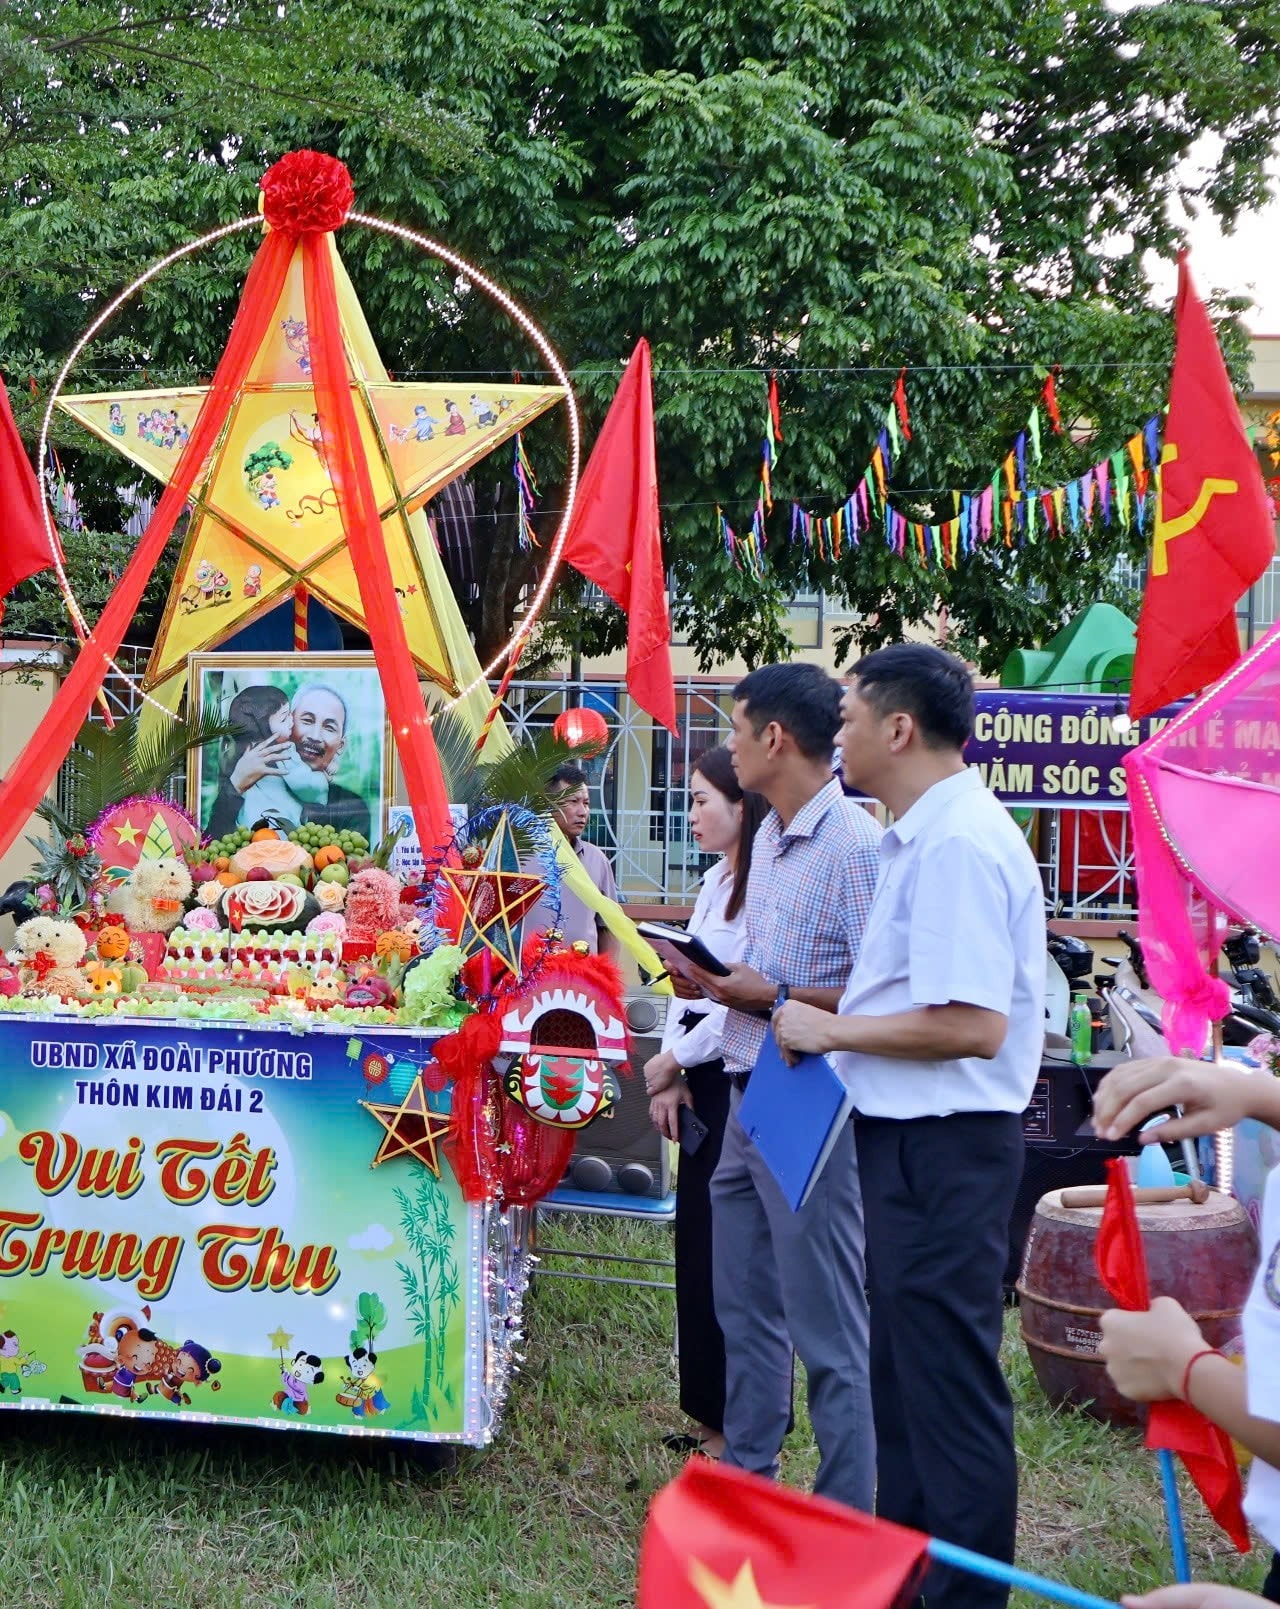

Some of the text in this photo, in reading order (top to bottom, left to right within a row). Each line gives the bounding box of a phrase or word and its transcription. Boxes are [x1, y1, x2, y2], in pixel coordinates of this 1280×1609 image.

[975, 707, 1052, 748] CỘNG
[1061, 706, 1140, 746] ĐỒNG
[1042, 760, 1100, 795] SÓC
[31, 1040, 313, 1080] UBND XÃ ĐOÀI PHƯƠNG
[75, 1077, 264, 1113] THÔN KIM ĐÁI 2
[18, 1130, 278, 1207] Vui Tết
[196, 1223, 341, 1296] Thu
